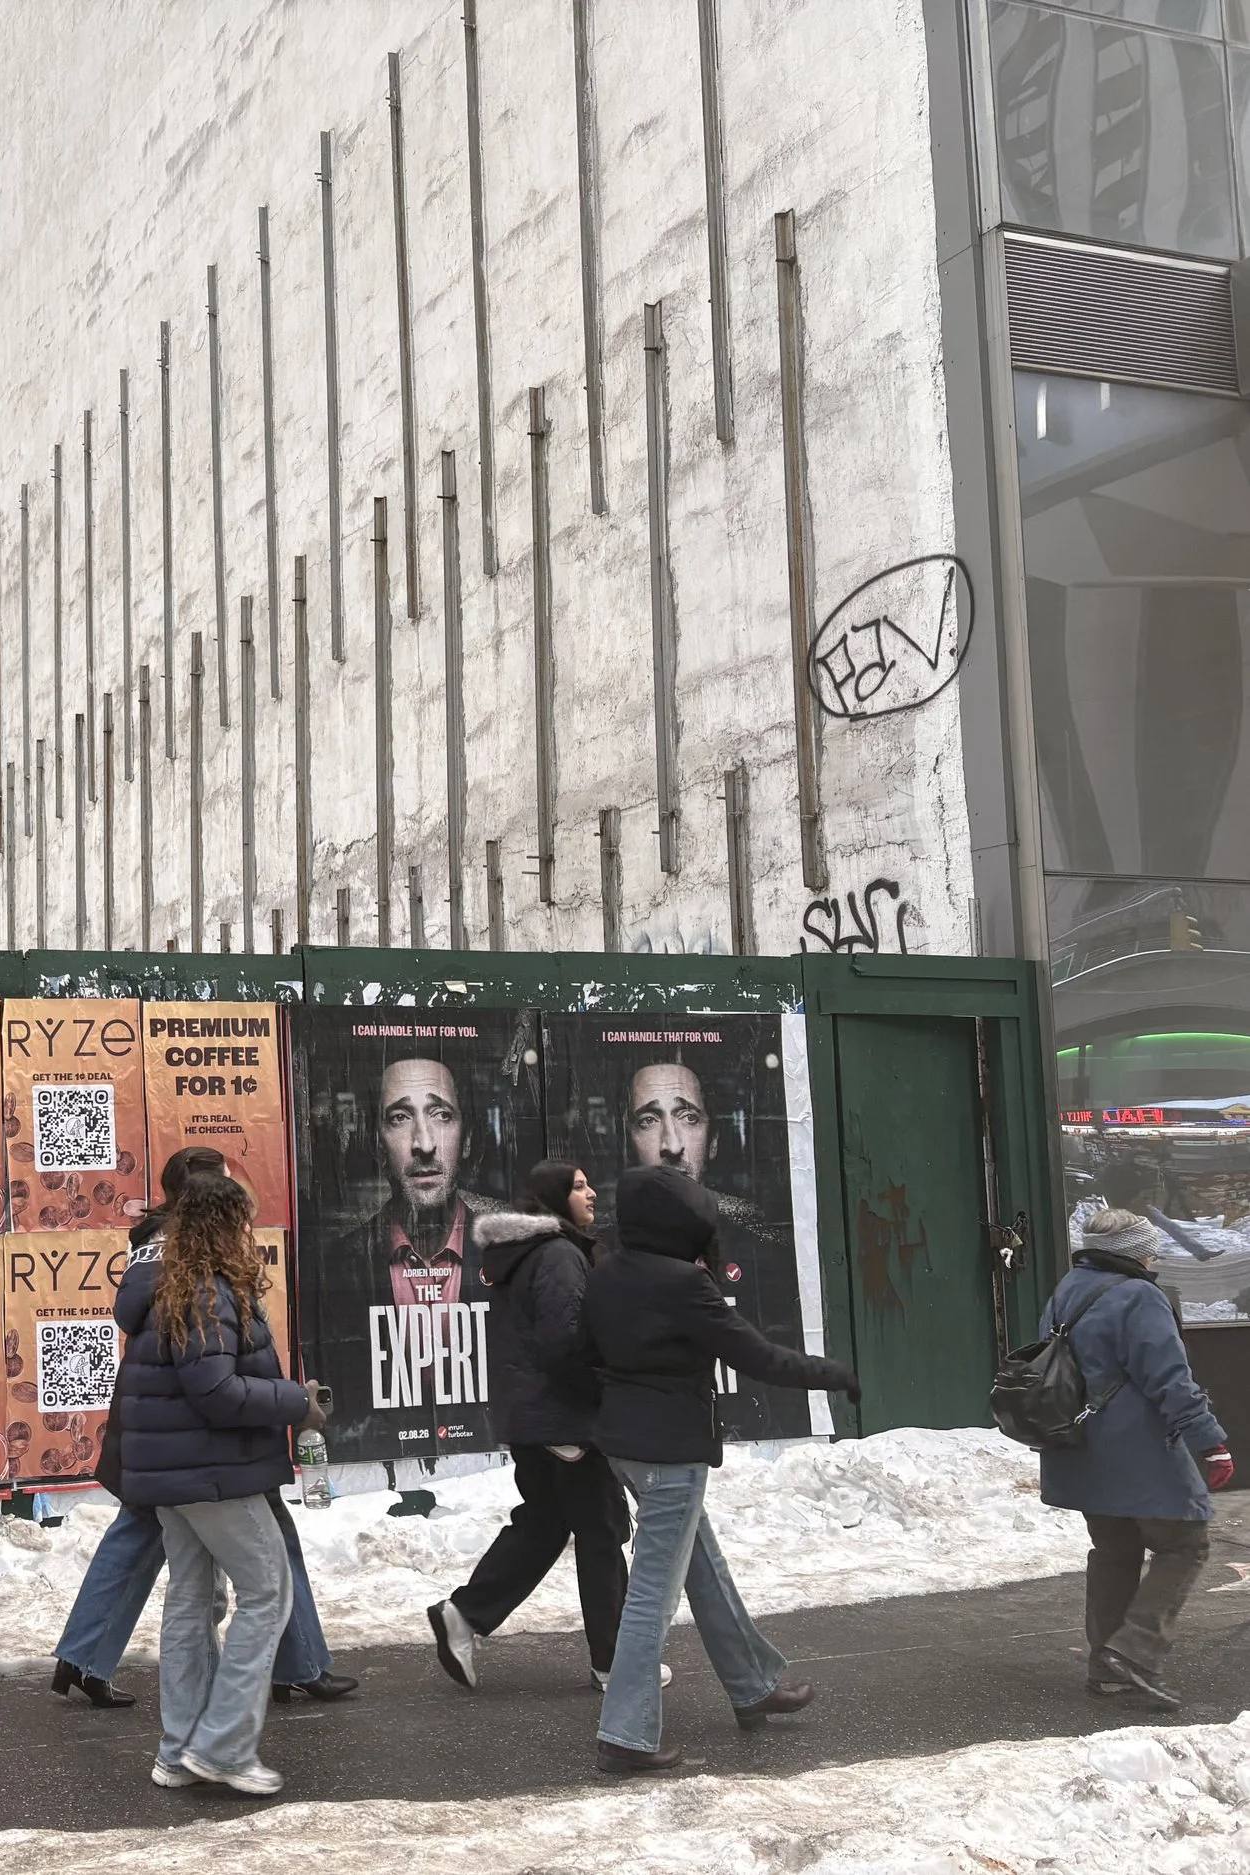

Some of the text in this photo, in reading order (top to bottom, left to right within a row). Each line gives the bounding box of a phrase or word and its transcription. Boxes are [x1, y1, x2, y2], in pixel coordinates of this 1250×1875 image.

[149, 1017, 270, 1038] PREMIUM
[352, 1025, 479, 1037] I CAN HANDLE THAT FOR YOU.
[602, 1031, 723, 1043] I CAN HANDLE THAT FOR YOU.
[165, 1046, 259, 1067] COFFEE
[32, 1073, 51, 1081] GET
[53, 1073, 73, 1081] THE
[87, 1072, 113, 1080] DEAL
[175, 1075, 258, 1096] FOR 1¢
[192, 1114, 237, 1123] IT'S REAL.
[184, 1126, 245, 1135] HE CHECKED.
[402, 1267, 453, 1278] ADRIEN BRODY
[415, 1284, 443, 1301] THE
[36, 1308, 55, 1317] GET
[57, 1308, 77, 1316] THE
[92, 1307, 114, 1316] DEA
[369, 1301, 490, 1409] EXPERT
